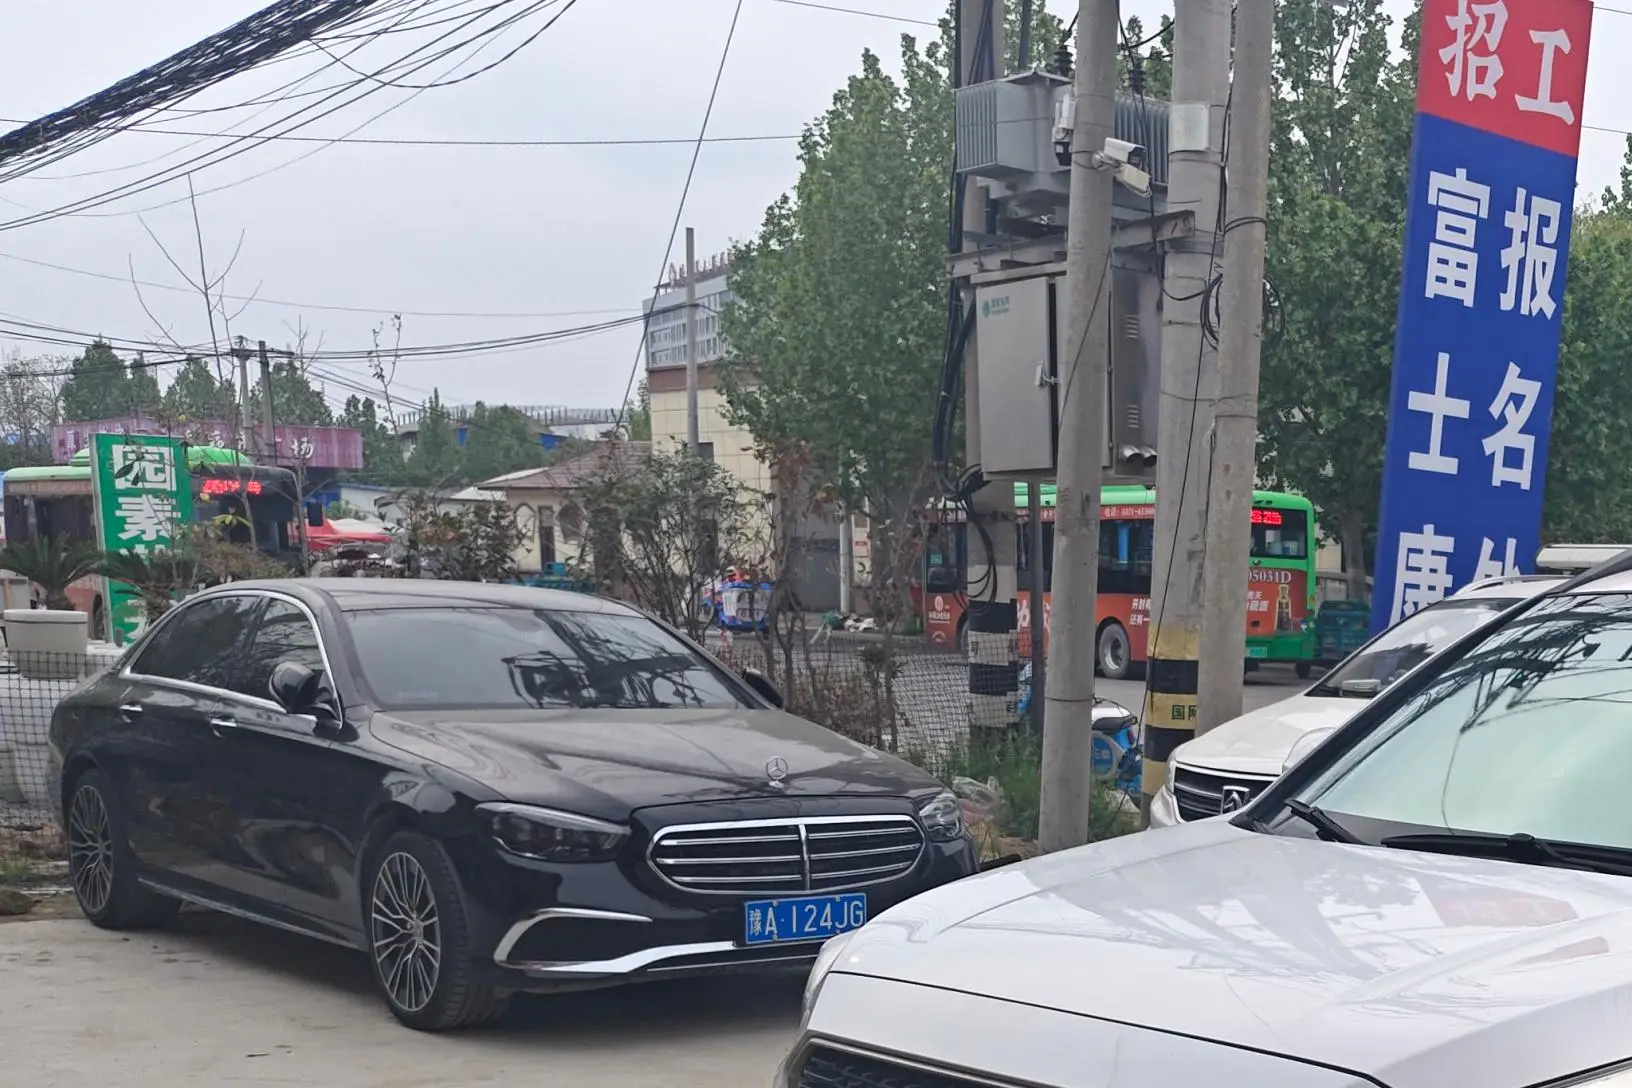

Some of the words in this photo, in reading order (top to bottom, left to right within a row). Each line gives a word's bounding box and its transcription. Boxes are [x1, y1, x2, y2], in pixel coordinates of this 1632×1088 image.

[1438, 0, 1574, 125] 招工
[1389, 168, 1491, 629] 富士康
